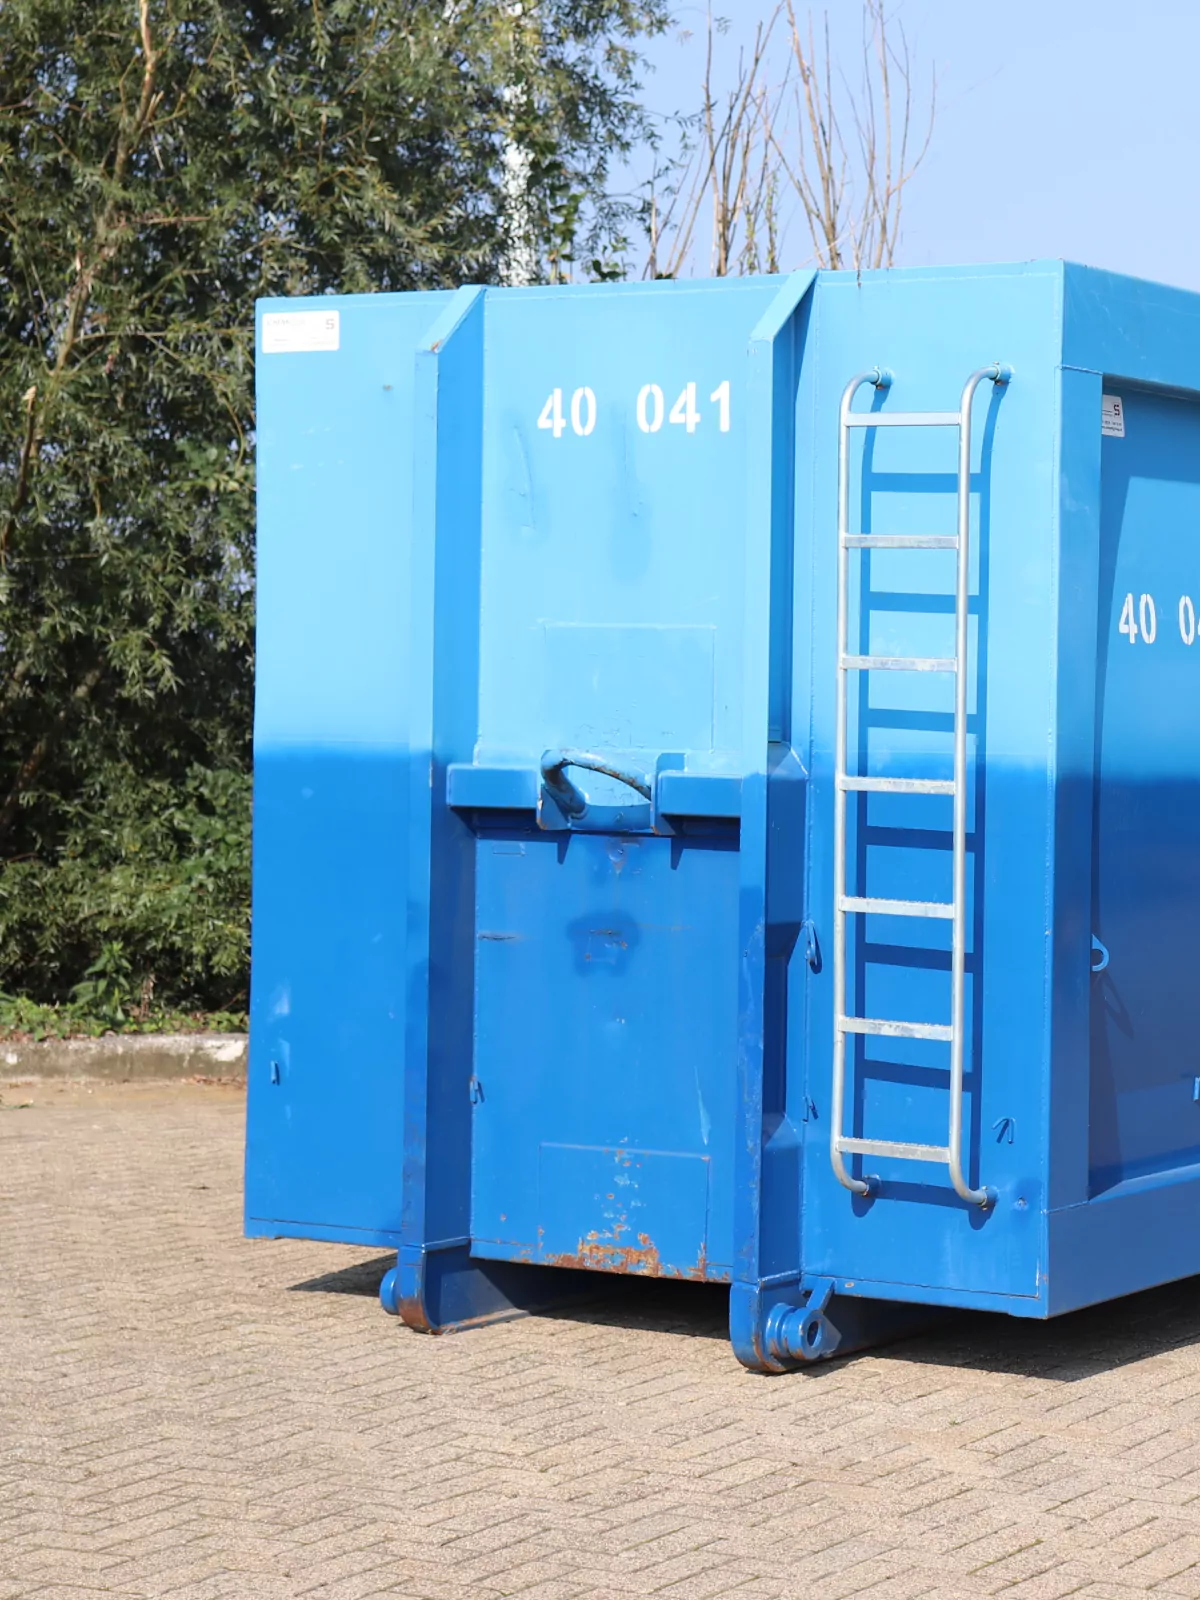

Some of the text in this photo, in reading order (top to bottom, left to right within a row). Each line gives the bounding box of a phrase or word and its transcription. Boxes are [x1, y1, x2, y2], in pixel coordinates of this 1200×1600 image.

[537, 380, 730, 438] 40 041
[1118, 593, 1157, 644] 40
